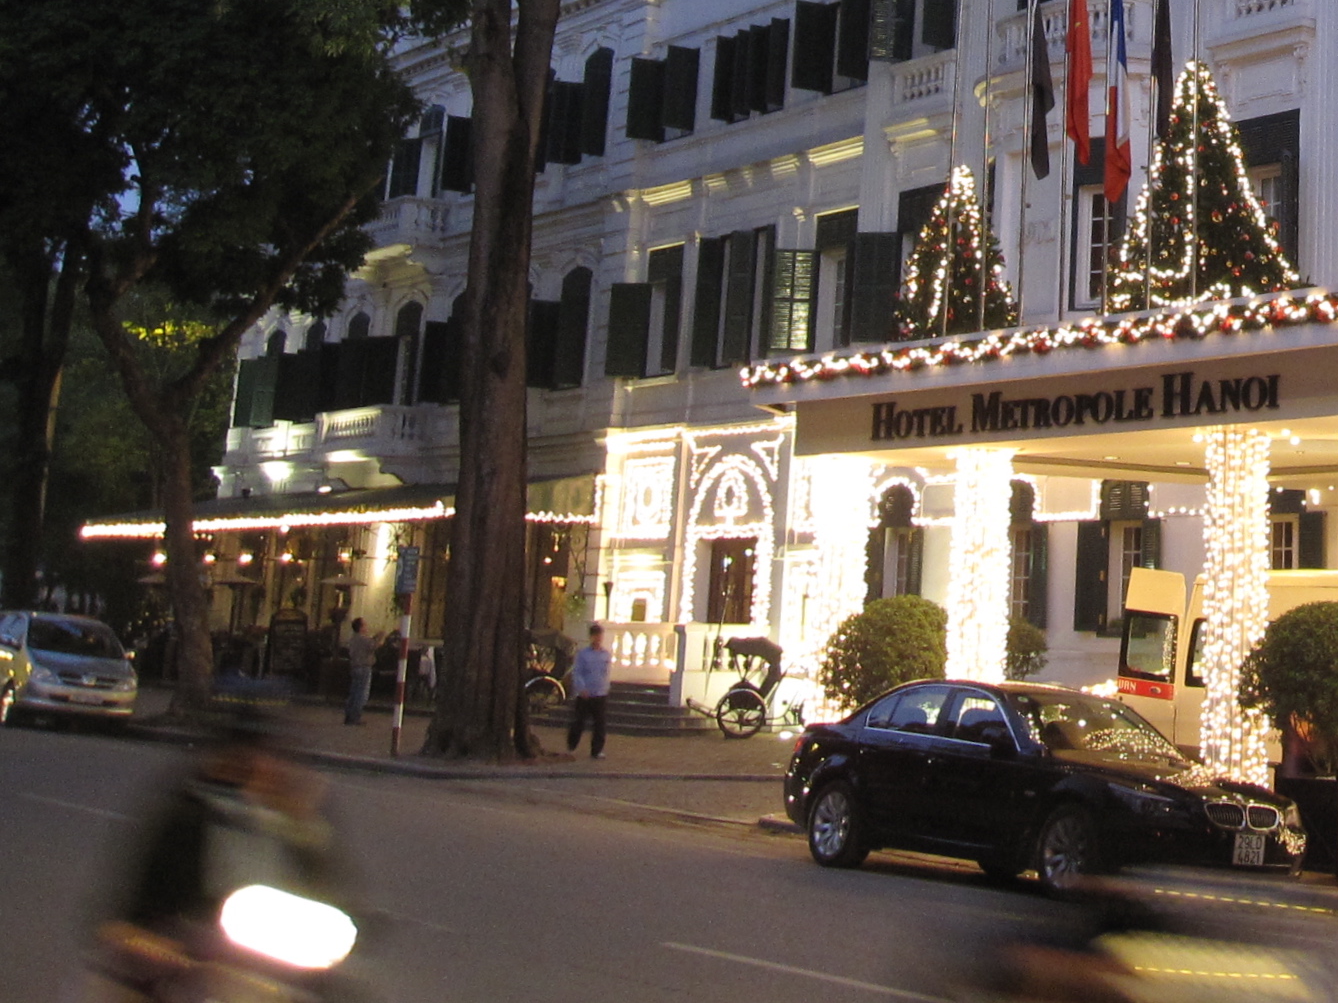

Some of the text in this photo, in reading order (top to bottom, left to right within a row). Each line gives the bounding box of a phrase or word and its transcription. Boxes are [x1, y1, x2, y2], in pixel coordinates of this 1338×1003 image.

[870, 372, 1281, 441] HOTEL METROPOLE HANOI
